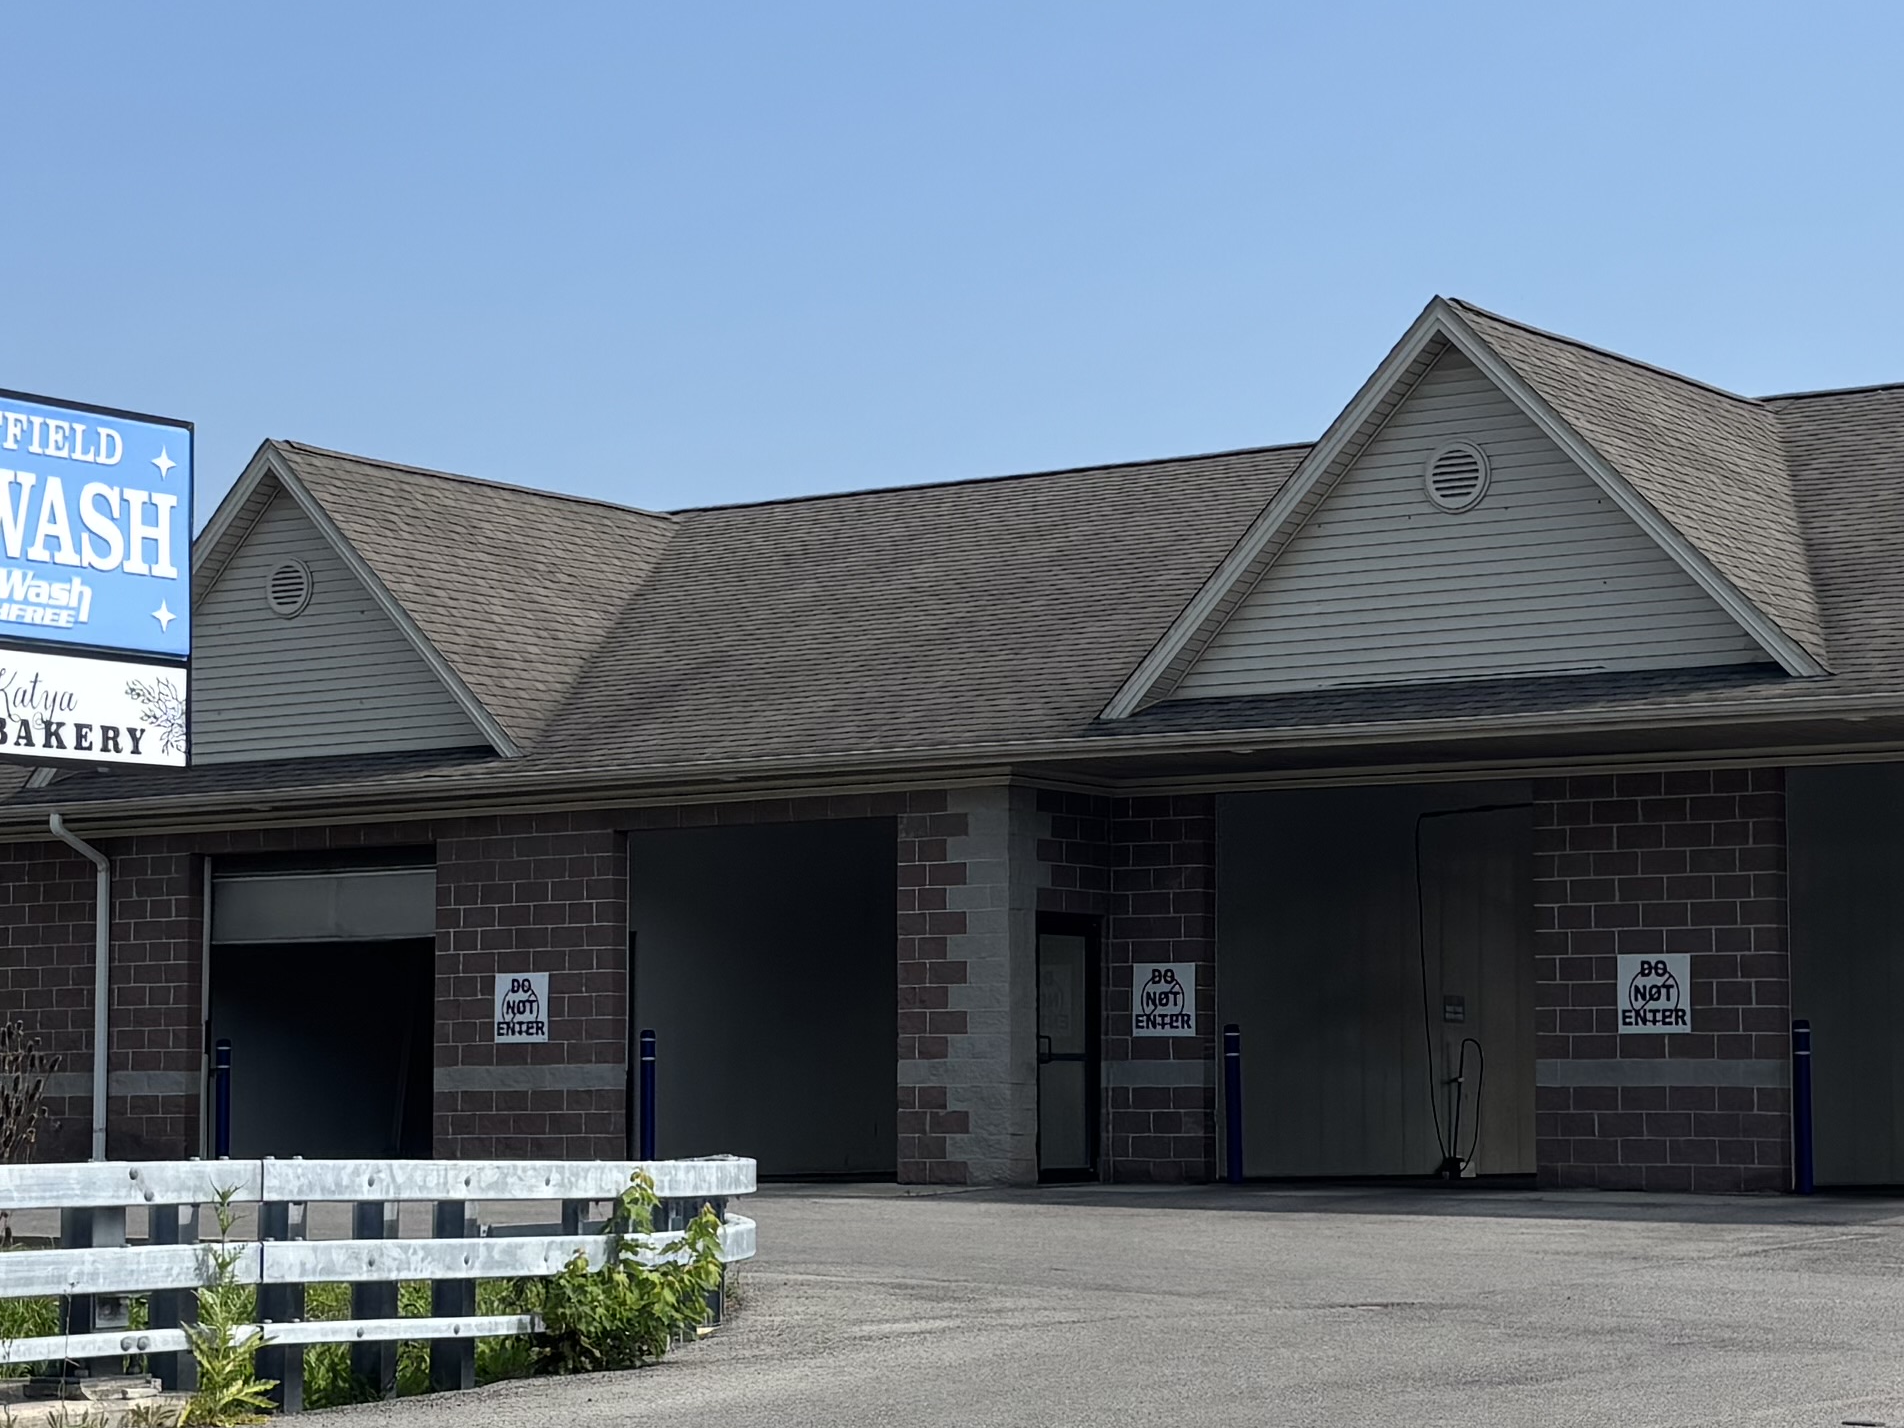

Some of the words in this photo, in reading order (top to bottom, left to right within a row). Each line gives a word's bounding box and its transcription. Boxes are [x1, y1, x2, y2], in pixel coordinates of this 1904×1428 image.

[1151, 968, 1176, 985] DO
[1640, 959, 1668, 978] DO
[511, 978, 531, 993] DO
[1633, 984, 1675, 1002] NOT
[505, 999, 537, 1015] NOT
[1145, 990, 1181, 1007] NOT
[1135, 1013, 1192, 1030] ENTER
[1621, 1008, 1688, 1026] ENTER
[496, 1020, 545, 1037] ENTER
